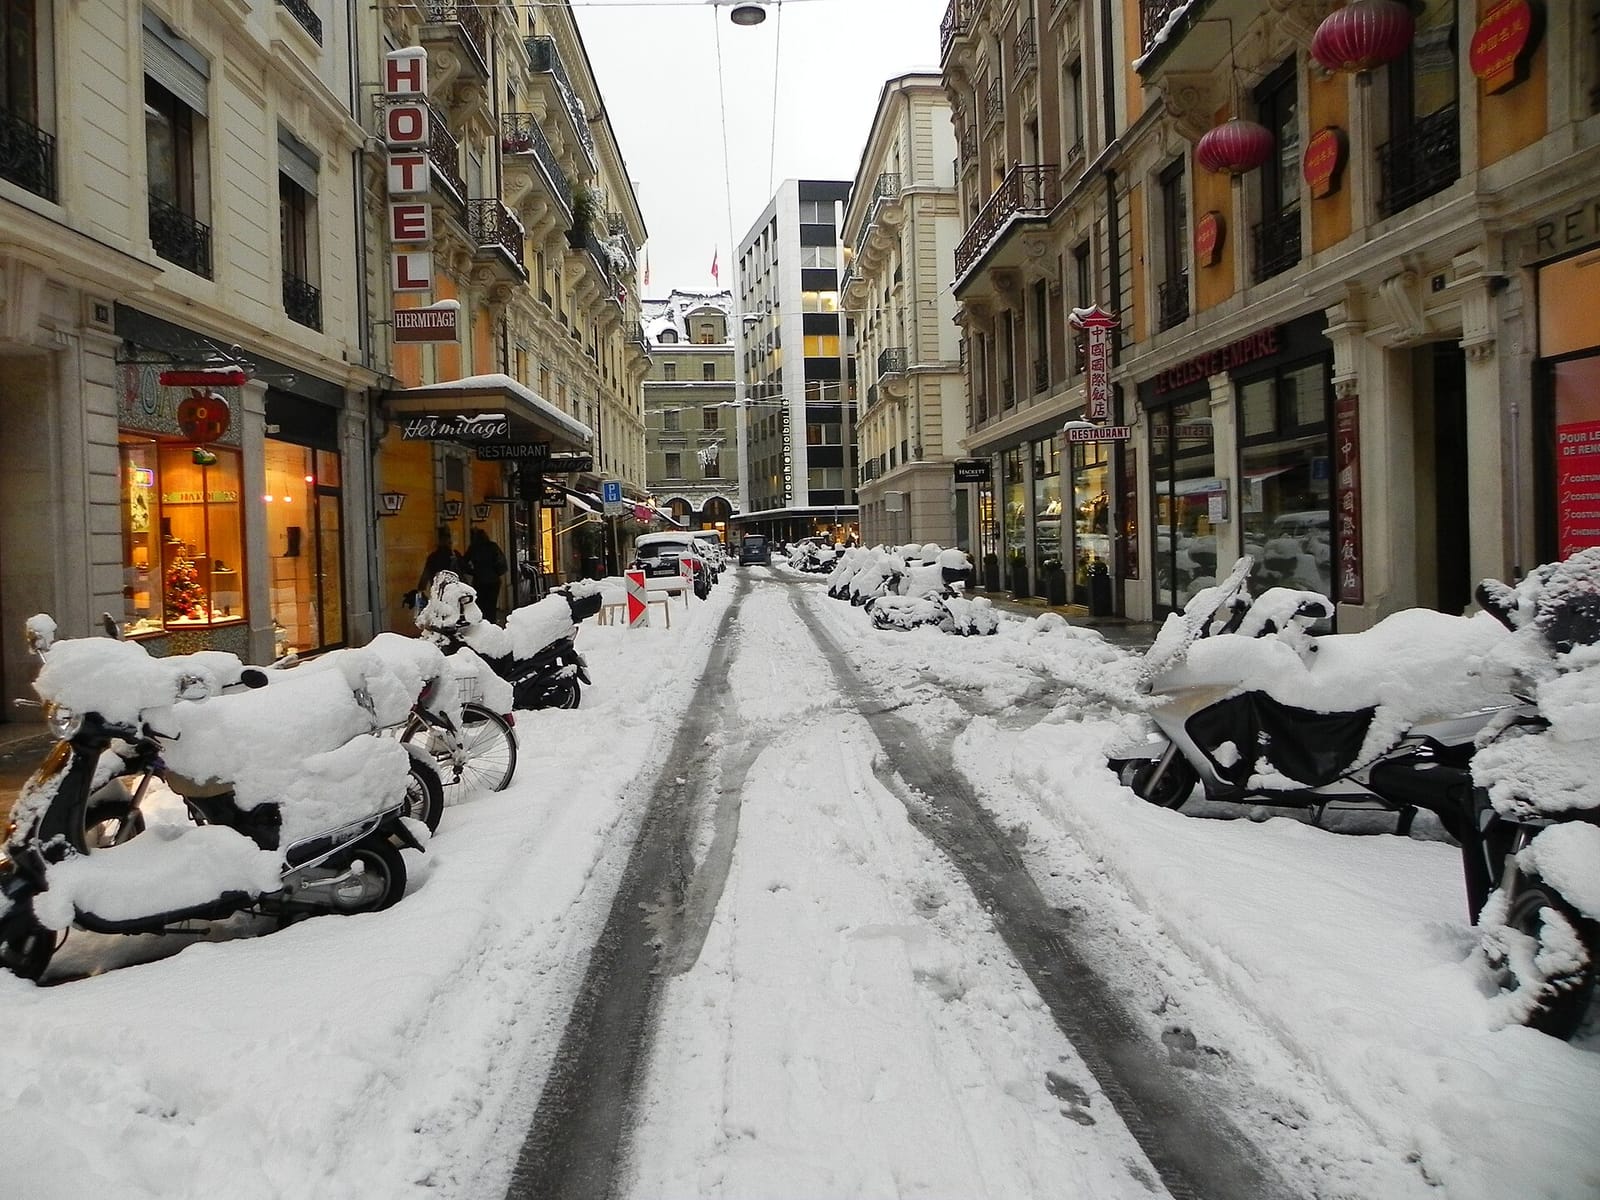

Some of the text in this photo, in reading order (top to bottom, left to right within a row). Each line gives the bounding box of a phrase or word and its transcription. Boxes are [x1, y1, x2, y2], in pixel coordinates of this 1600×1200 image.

[386, 58, 430, 289] HOTEL
[396, 311, 455, 328] HERMITAGE
[1222, 328, 1280, 369] EMPIRE
[402, 418, 508, 441] Hermitage
[1071, 428, 1128, 440] RESTAURANT
[478, 444, 548, 459] RESTAURANT
[1563, 446, 1577, 456] DE
[608, 484, 616, 494] P
